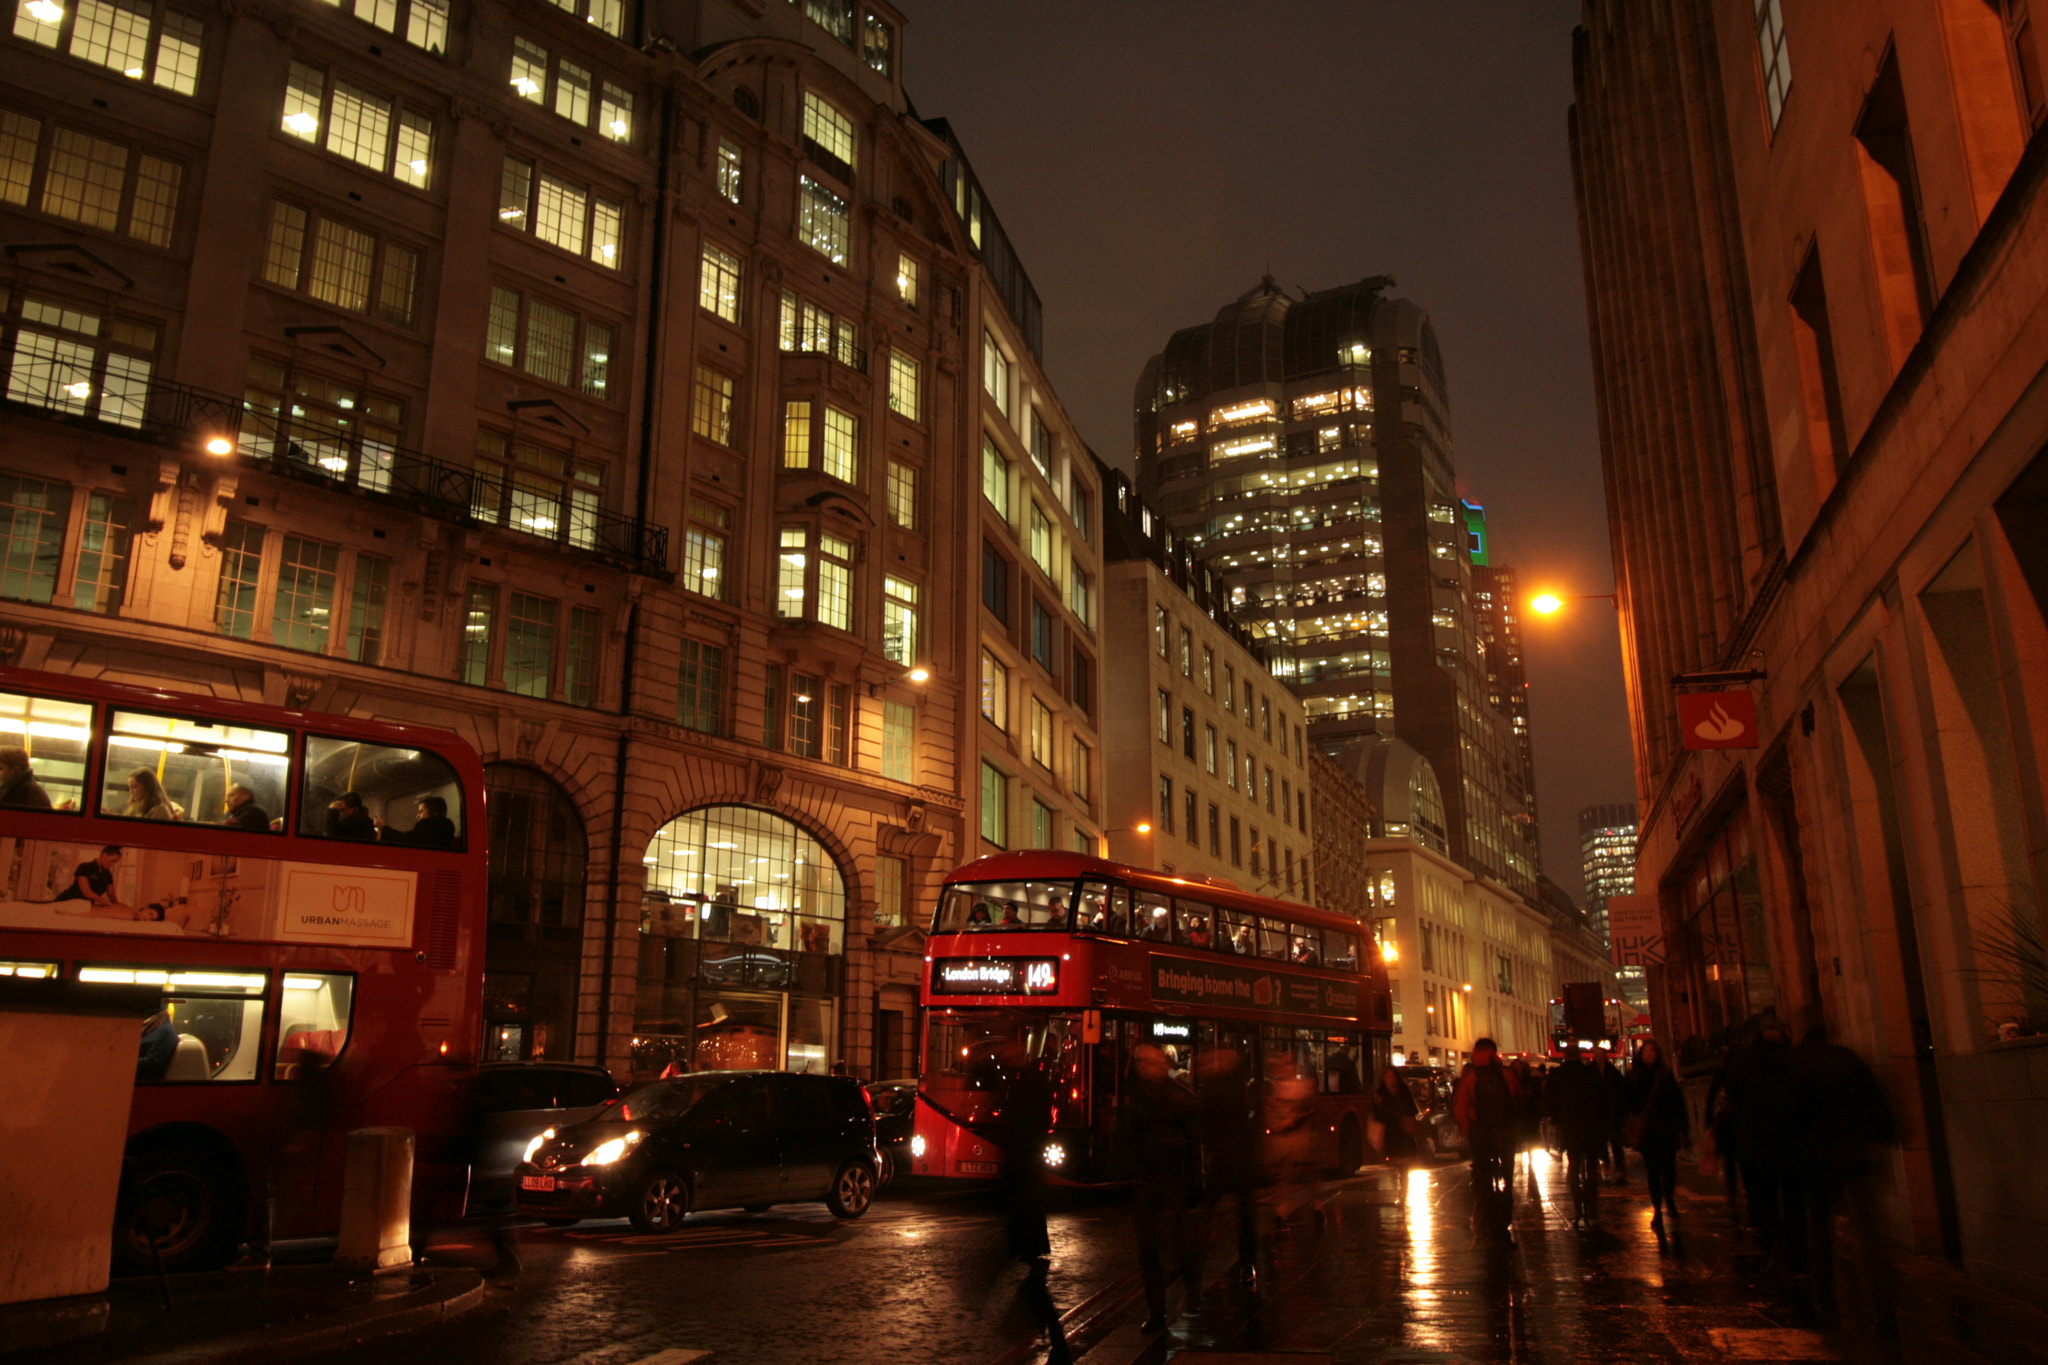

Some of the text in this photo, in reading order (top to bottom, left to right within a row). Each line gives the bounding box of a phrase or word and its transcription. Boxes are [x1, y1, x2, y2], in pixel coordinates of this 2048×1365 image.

[301, 915, 391, 929] URBANMASSAGE
[945, 962, 1052, 988] London Bridge 149
[1158, 968, 1205, 997] Bringing
[1205, 974, 1235, 996] home
[1235, 978, 1251, 998] the
[1153, 1022, 1164, 1036] 149
